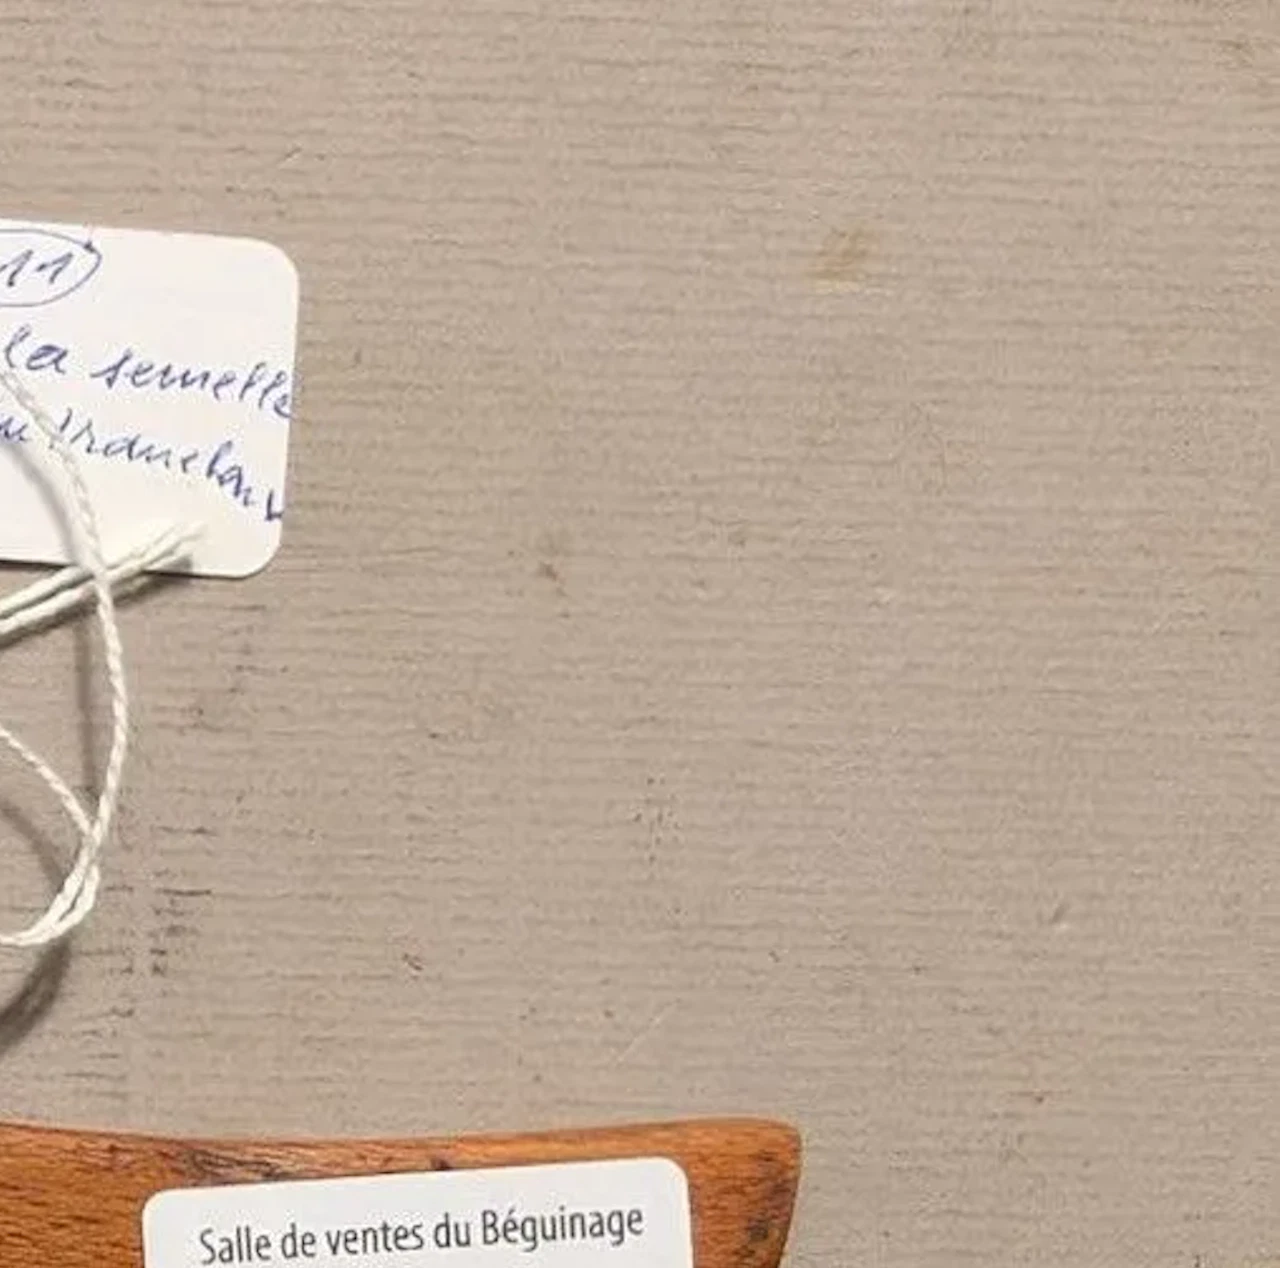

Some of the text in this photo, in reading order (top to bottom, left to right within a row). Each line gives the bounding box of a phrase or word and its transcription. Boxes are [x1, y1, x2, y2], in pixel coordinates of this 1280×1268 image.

[200, 1204, 644, 1267] Salle de ventes du Béguinage
